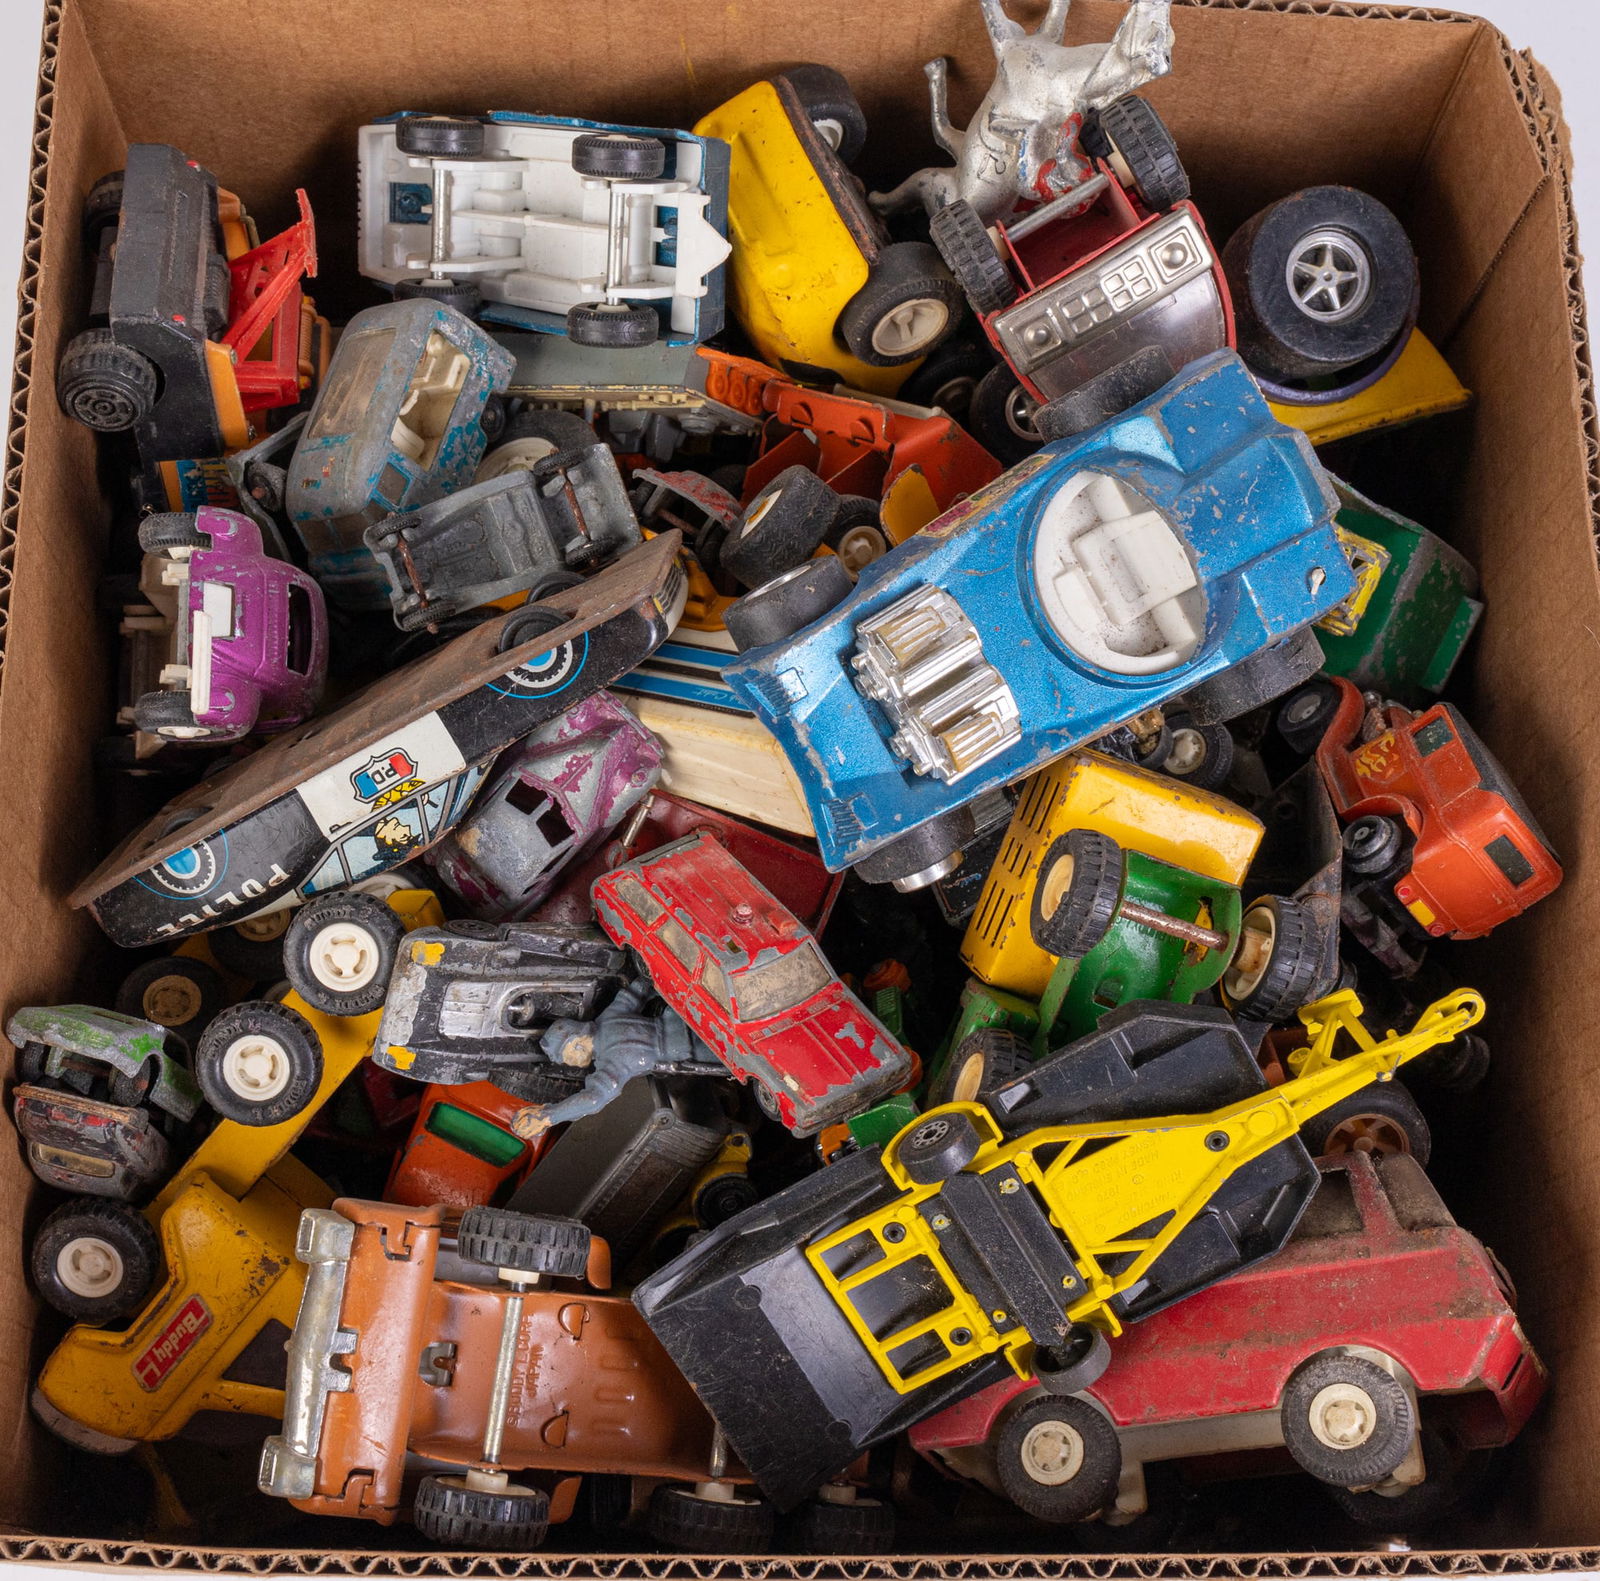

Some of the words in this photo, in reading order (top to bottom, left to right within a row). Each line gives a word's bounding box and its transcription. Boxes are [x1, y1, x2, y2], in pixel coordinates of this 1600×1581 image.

[365, 763, 397, 787] P.D.
[157, 864, 290, 936] POLICE
[153, 1311, 201, 1362] Buddy
